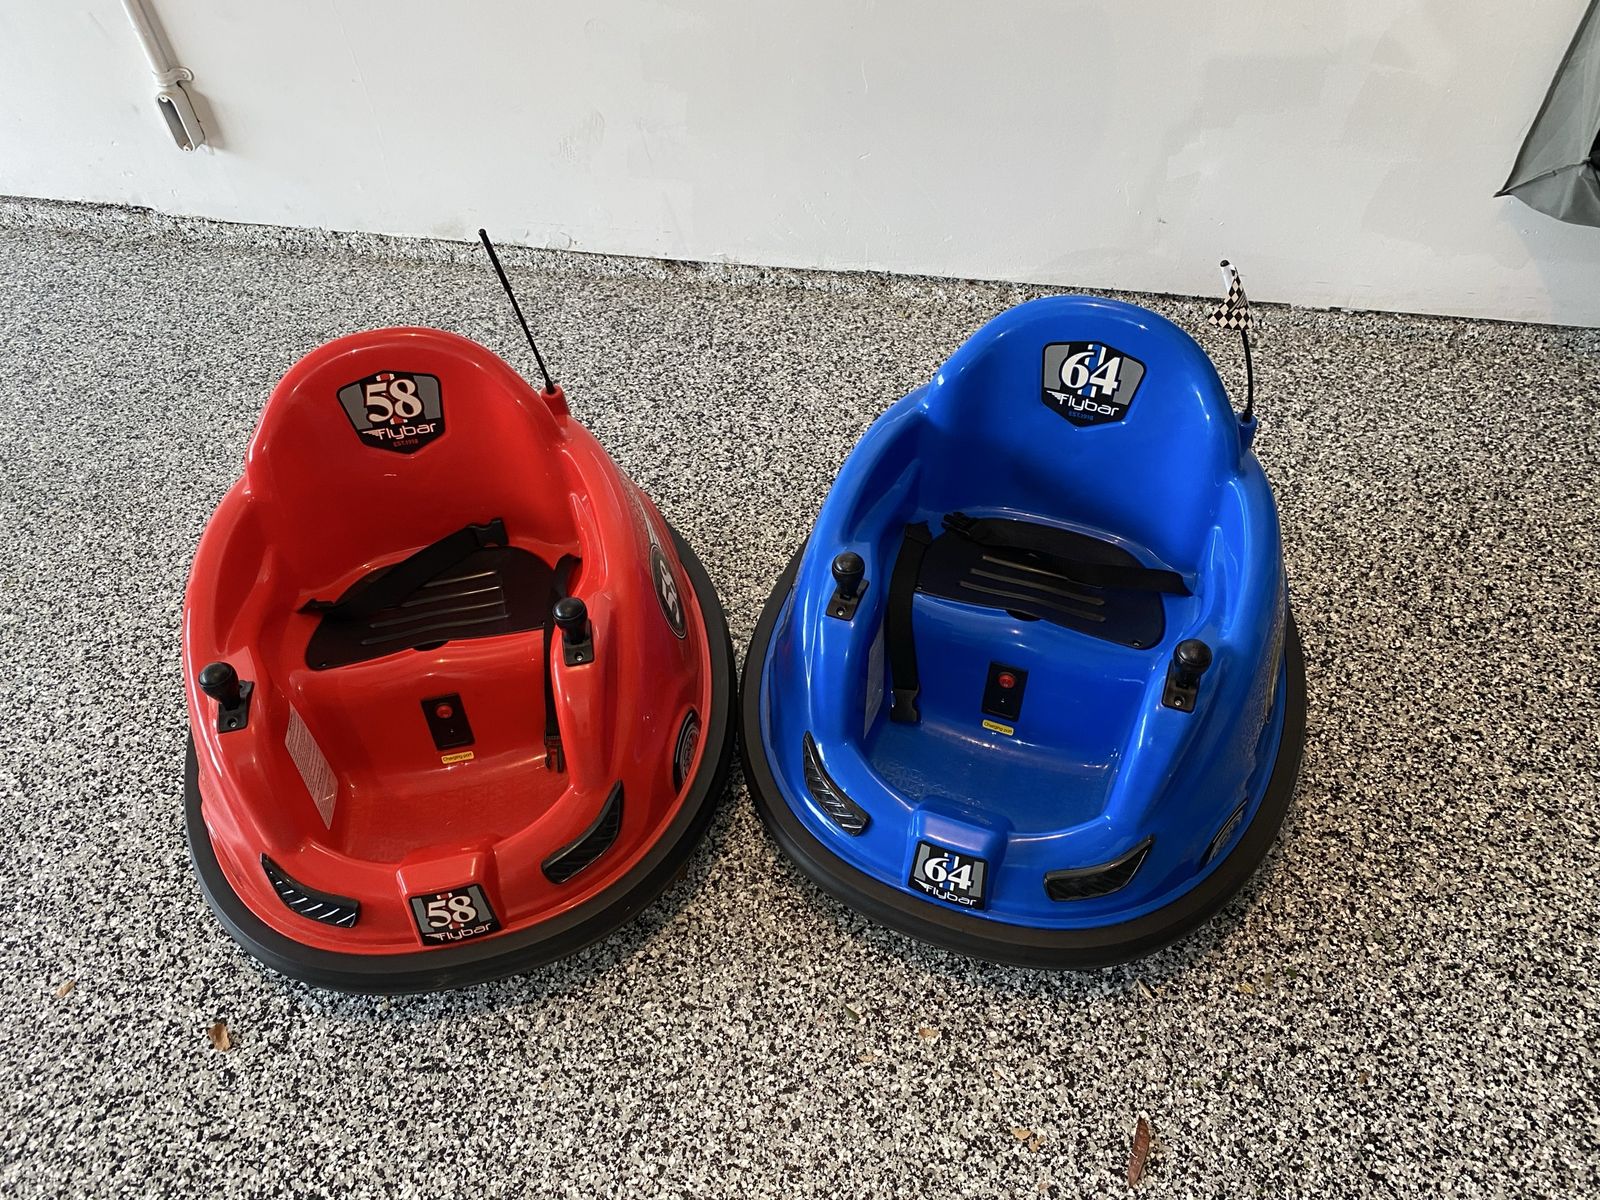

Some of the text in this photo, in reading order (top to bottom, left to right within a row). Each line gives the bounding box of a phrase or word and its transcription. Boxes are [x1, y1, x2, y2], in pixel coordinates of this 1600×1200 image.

[1061, 352, 1121, 396] 64
[366, 379, 423, 423] 58
[1054, 393, 1120, 417] flybar
[373, 423, 437, 440] flybar
[924, 857, 972, 891] 64
[920, 883, 978, 906] flybar
[428, 895, 477, 928] 58
[433, 923, 492, 941] flybar
